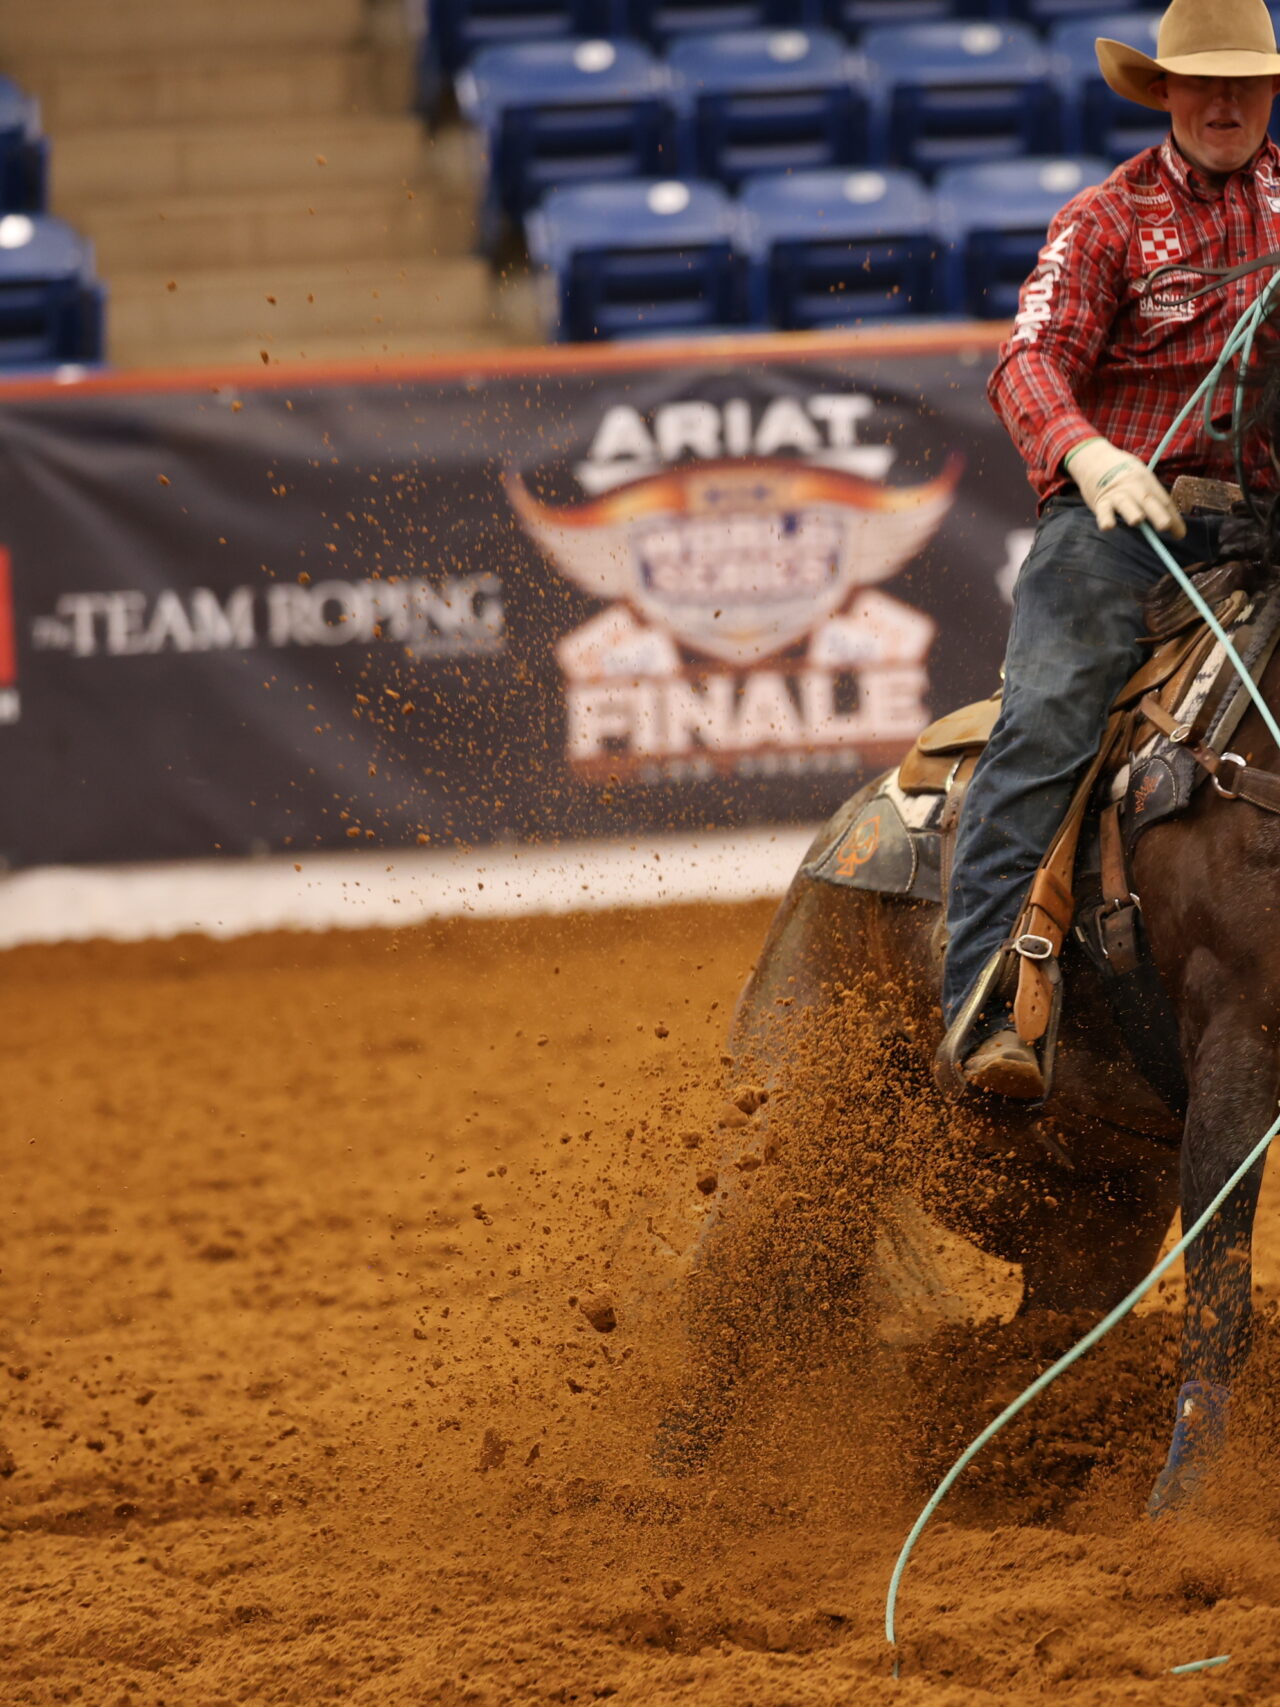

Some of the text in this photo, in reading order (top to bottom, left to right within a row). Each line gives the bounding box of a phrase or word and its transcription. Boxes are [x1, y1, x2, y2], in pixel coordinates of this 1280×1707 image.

[577, 393, 895, 495] ARIAT
[56, 588, 256, 656] TEAM
[267, 574, 503, 648] ROPING
[566, 668, 932, 762] FINALE
